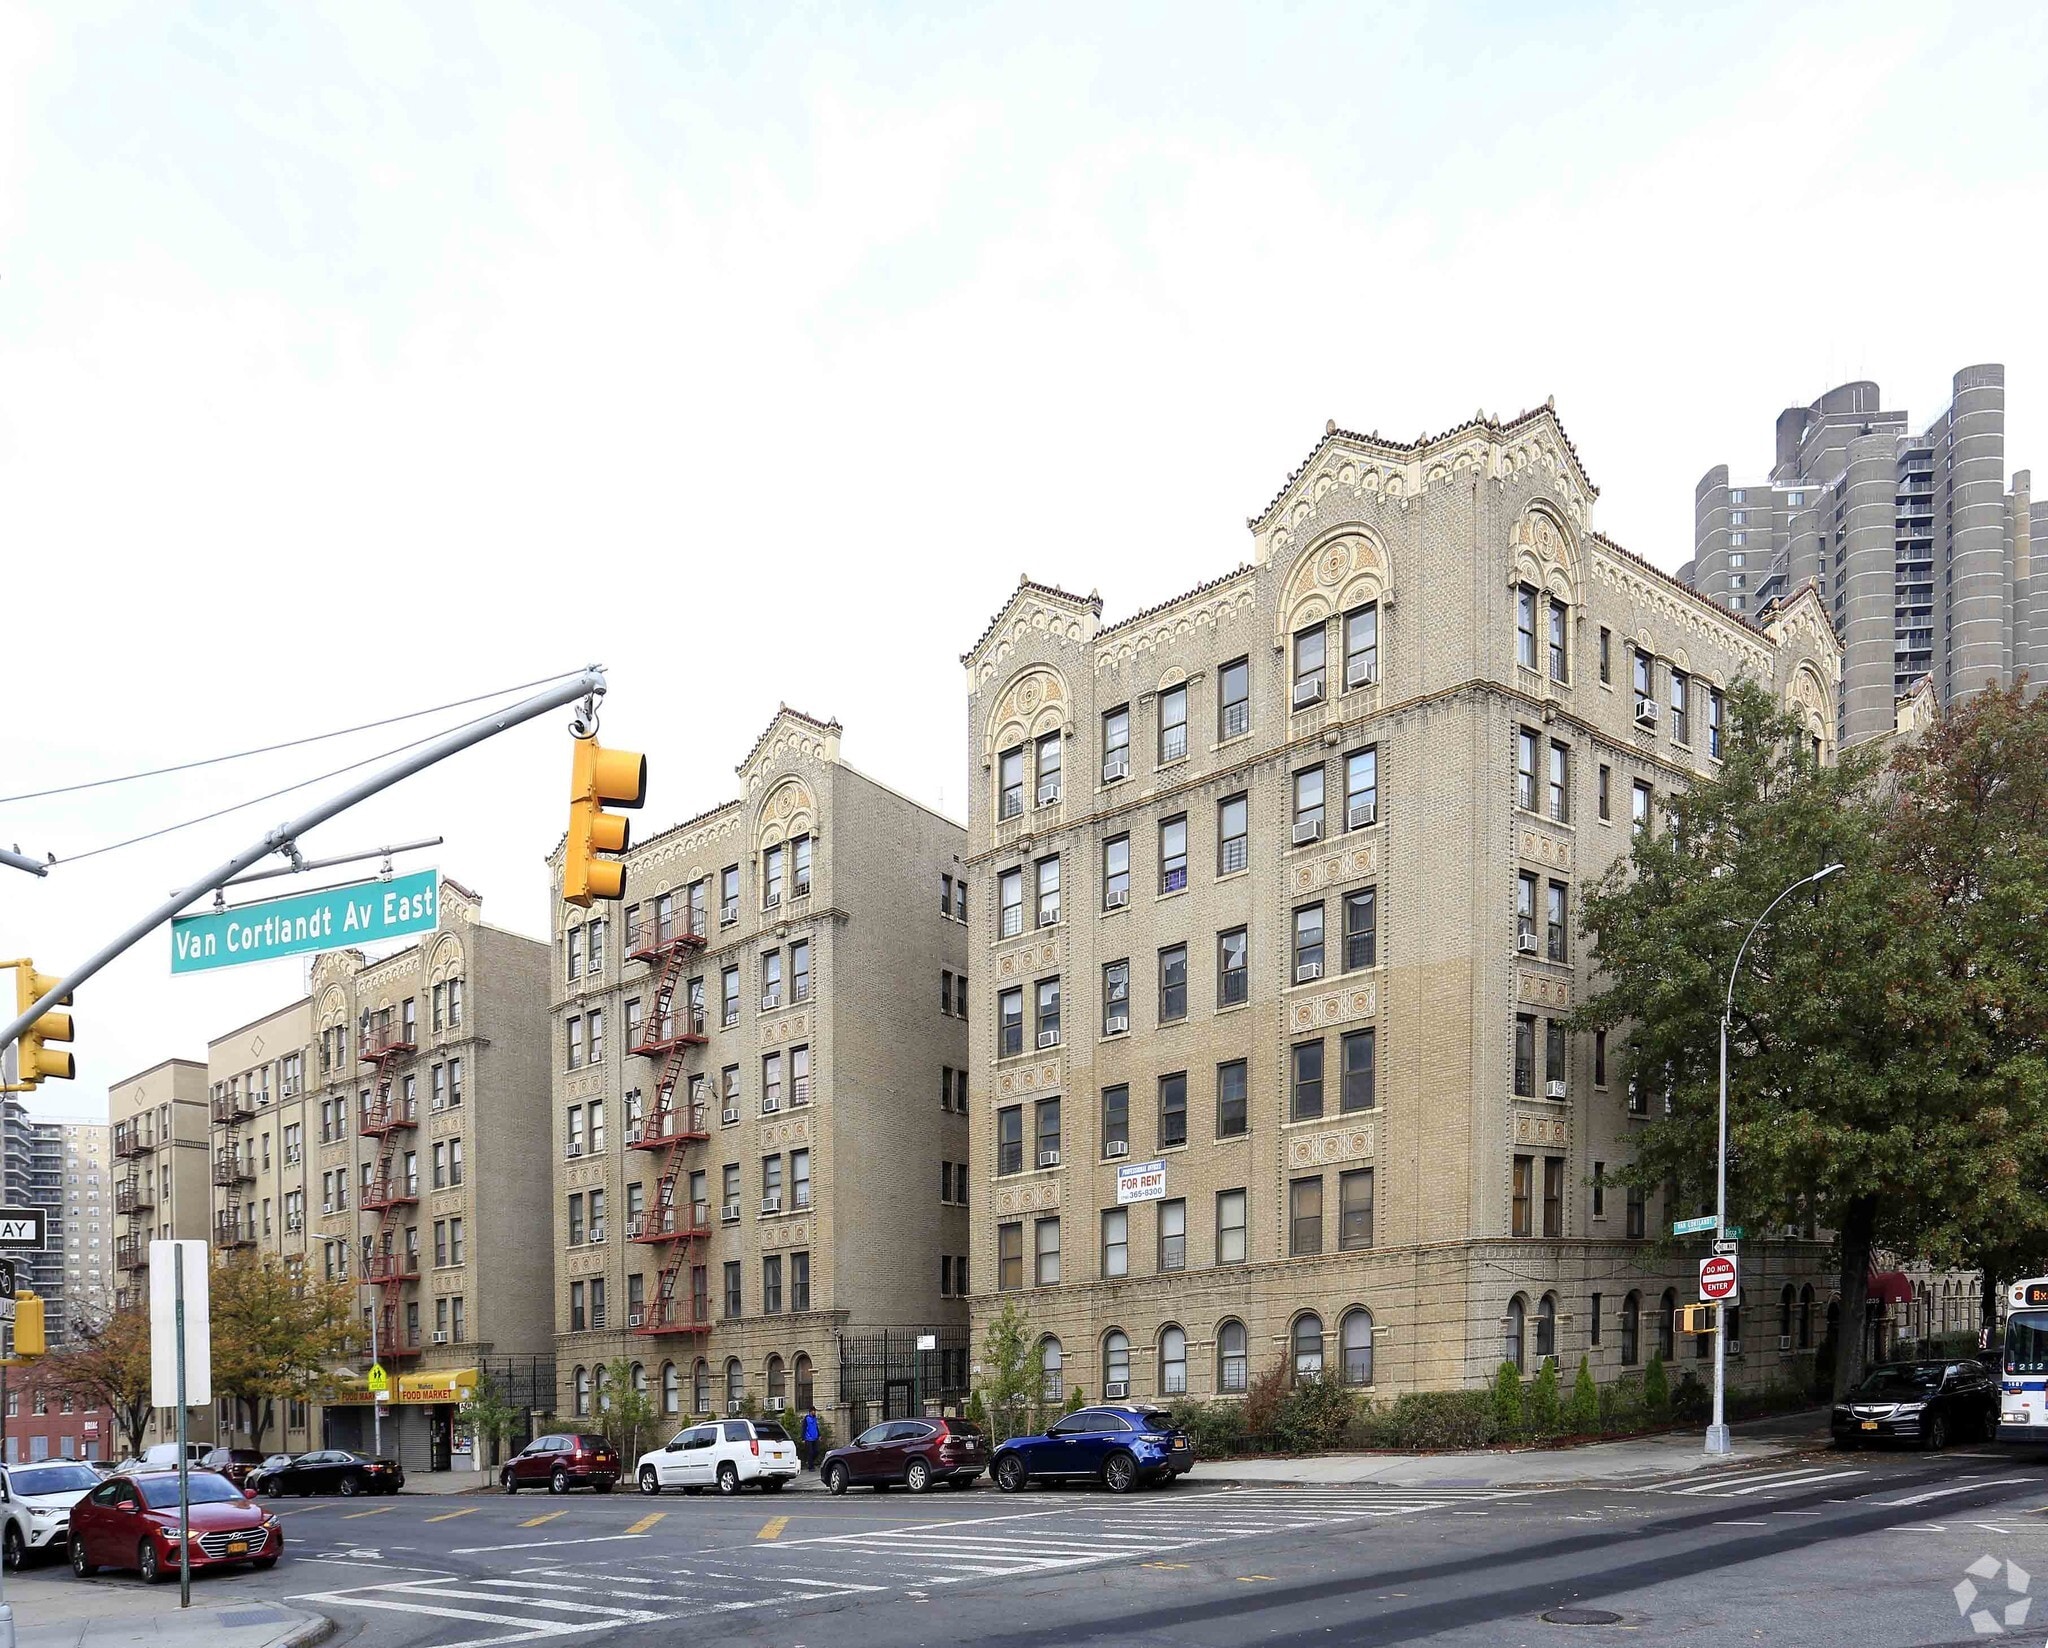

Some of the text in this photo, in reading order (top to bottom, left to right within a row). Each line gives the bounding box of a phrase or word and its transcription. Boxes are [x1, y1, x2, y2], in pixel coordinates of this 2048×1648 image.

[175, 885, 433, 960] Van Cortlandt Av East
[1121, 1174, 1162, 1191] FOR RENT
[1129, 1187, 1162, 1199] 365-8300
[0, 1222, 26, 1237] AY
[1706, 1264, 1729, 1274] DO NOT
[1707, 1282, 1728, 1291] ENTER
[2033, 1290, 2048, 1301] Bx
[342, 1391, 358, 1401] FOOD
[359, 1391, 376, 1400] MARK
[402, 1389, 452, 1400] FOOD MARKET
